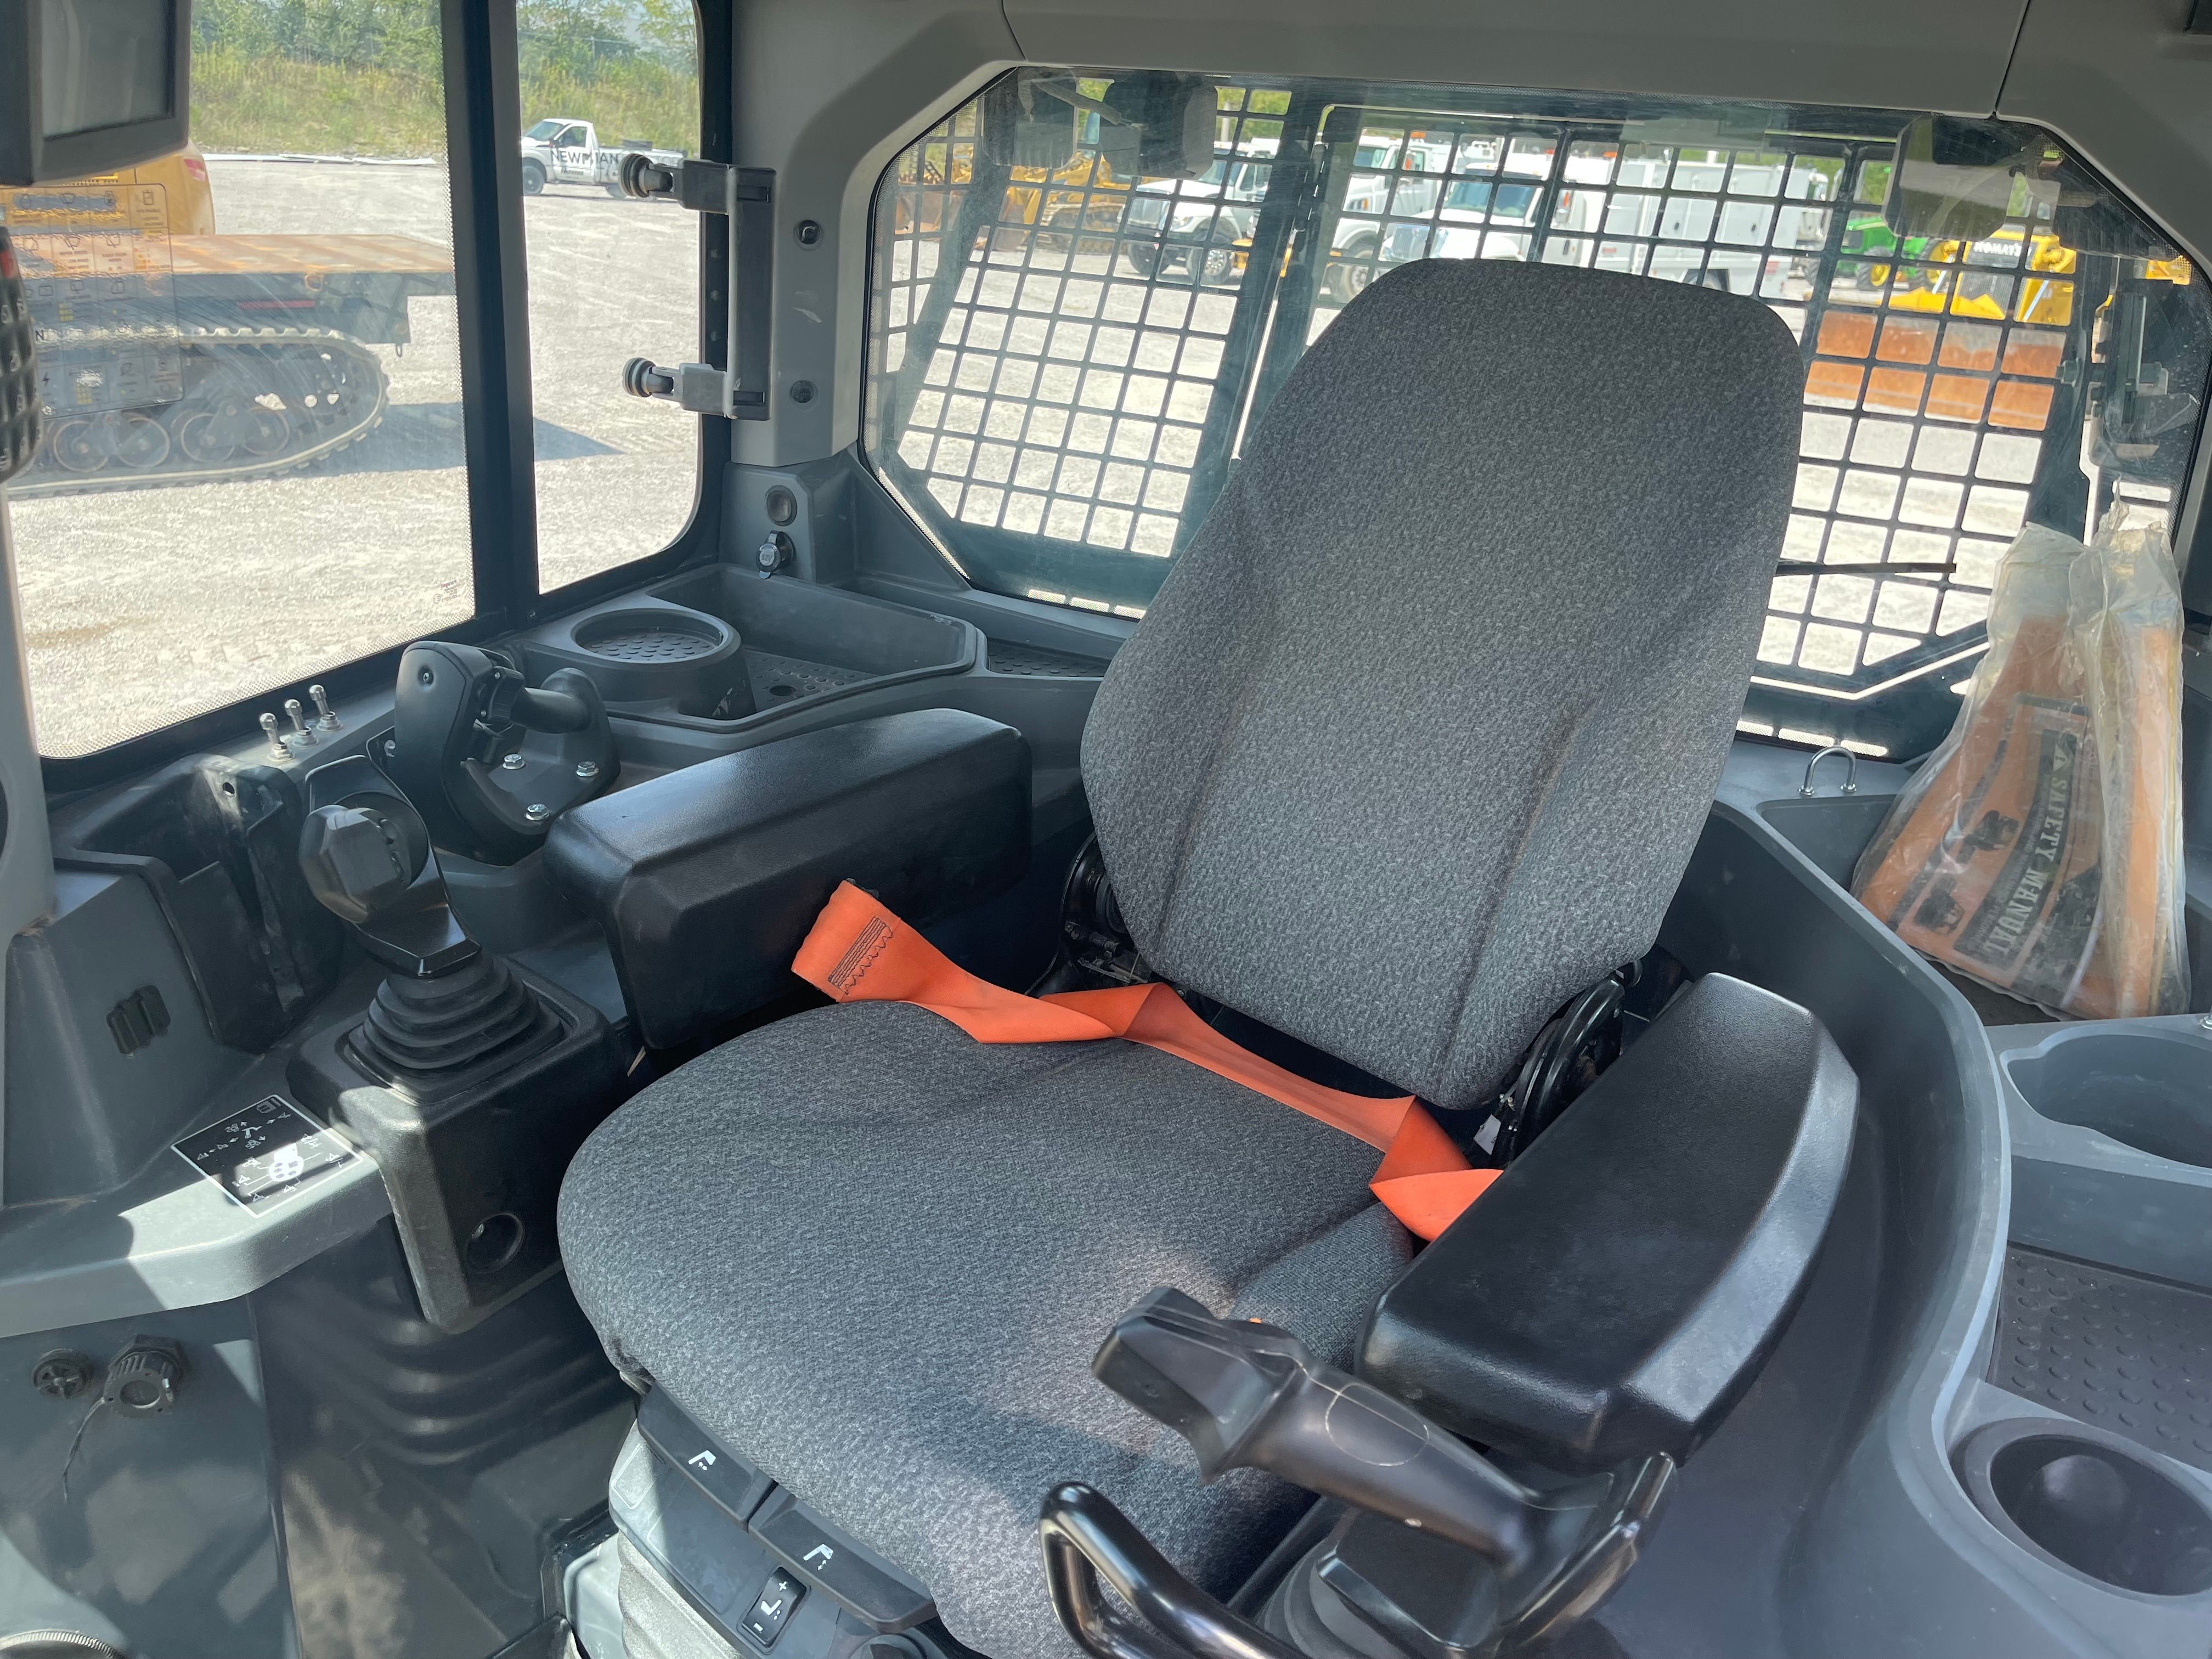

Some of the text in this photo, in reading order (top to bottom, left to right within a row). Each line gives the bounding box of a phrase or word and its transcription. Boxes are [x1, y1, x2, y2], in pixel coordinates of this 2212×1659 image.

[761, 554, 773, 562] 12V
[2034, 777, 2068, 862] SAFETY
[1983, 866, 2049, 955] MANUAL
